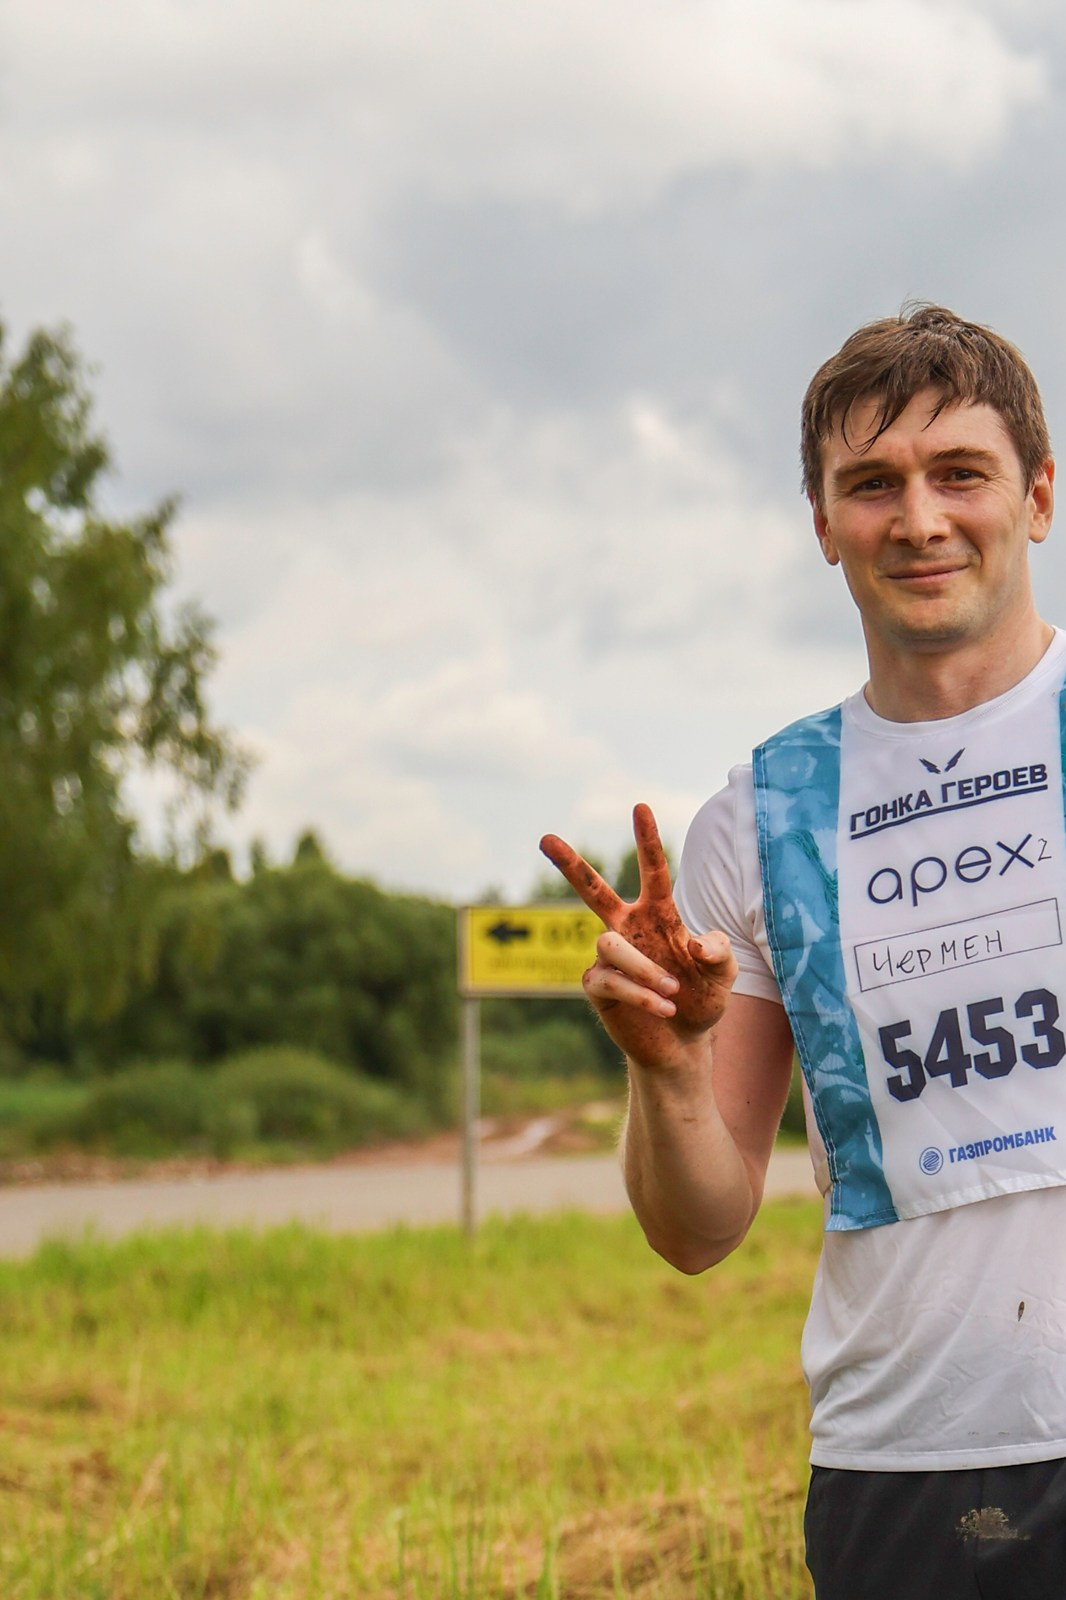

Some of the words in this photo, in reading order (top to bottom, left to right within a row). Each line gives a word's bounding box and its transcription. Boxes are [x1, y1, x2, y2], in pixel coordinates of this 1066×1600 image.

[850, 789, 933, 832] ГОНКА
[941, 763, 1048, 803] ГЕРОЕВ
[867, 833, 1035, 907] apex
[878, 988, 1066, 1102] 5453
[948, 1126, 1057, 1164] ГАЗПРОМБАНК
